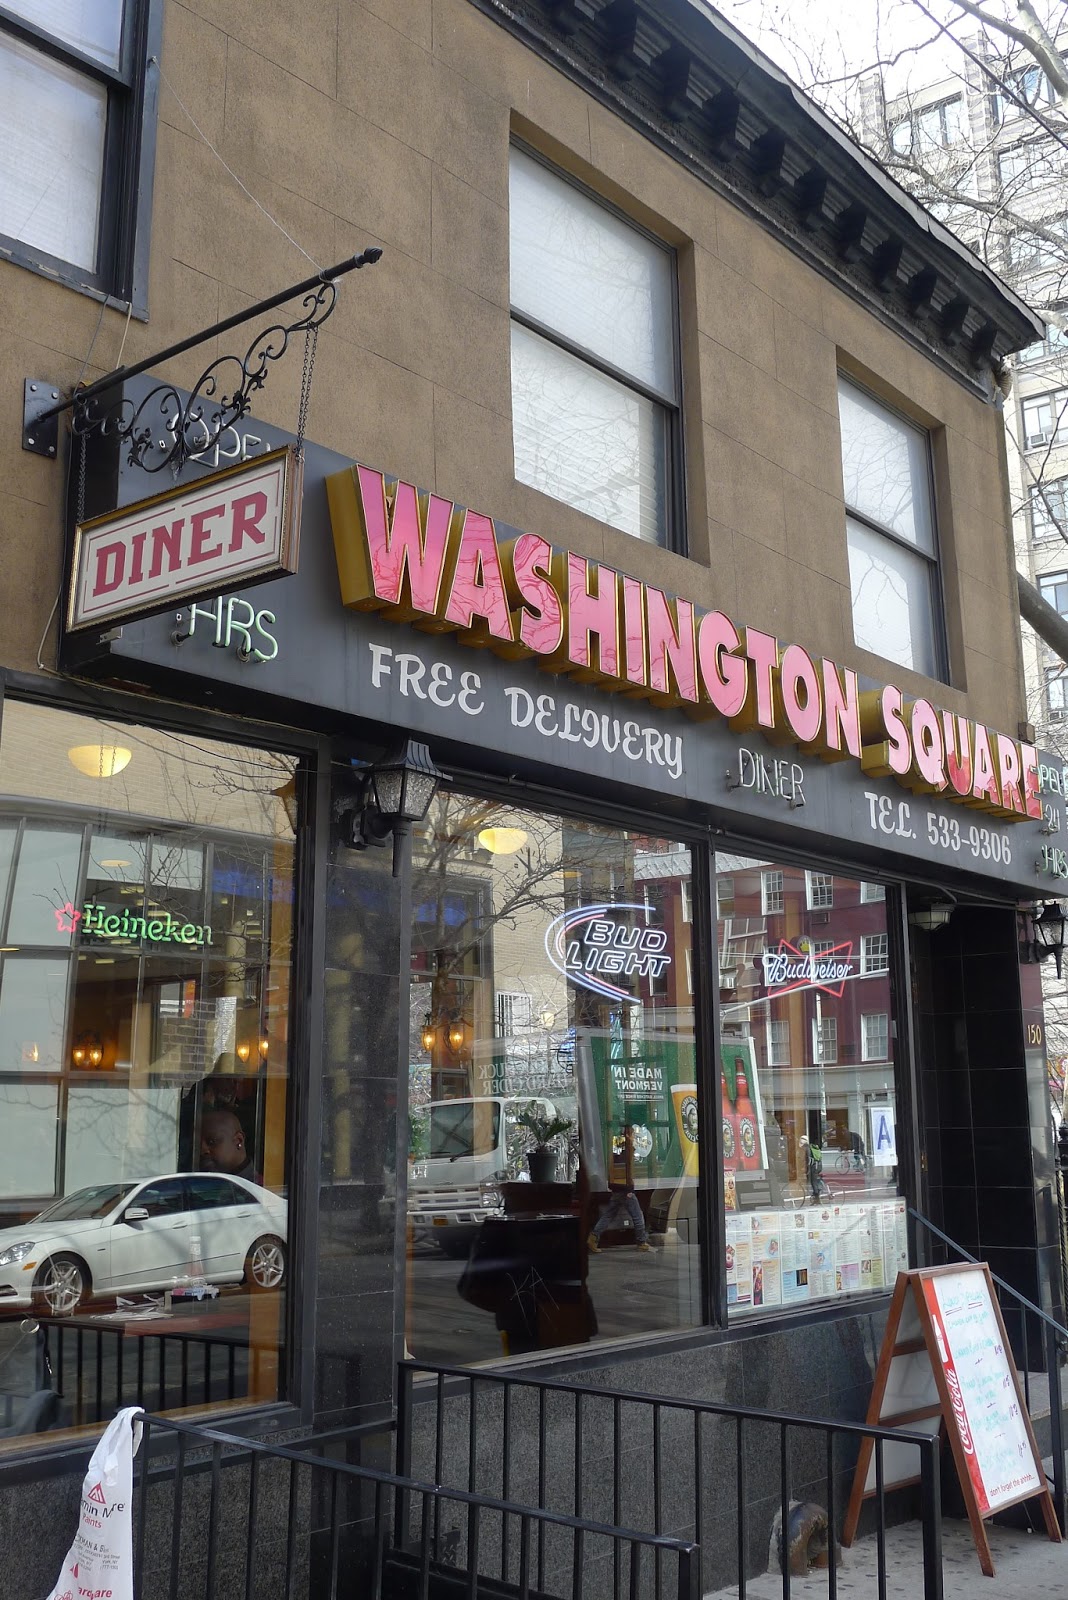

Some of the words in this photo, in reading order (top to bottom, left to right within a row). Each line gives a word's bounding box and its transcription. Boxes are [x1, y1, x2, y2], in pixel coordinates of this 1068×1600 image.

[92, 490, 269, 598] DINER
[188, 595, 279, 662] HRS
[357, 464, 862, 760] WASHINGTON
[881, 684, 1043, 821] SQUARE
[368, 642, 485, 716] FREE
[738, 747, 806, 806] DINER
[864, 791, 918, 840] TEL.
[926, 811, 1012, 865] 533-9306
[81, 903, 214, 946] Heineken
[584, 919, 667, 953] BUD
[563, 941, 672, 978] LIGHT
[761, 953, 854, 983] Budweiser
[1027, 1023, 1042, 1045] 150
[877, 1115, 892, 1150] A
